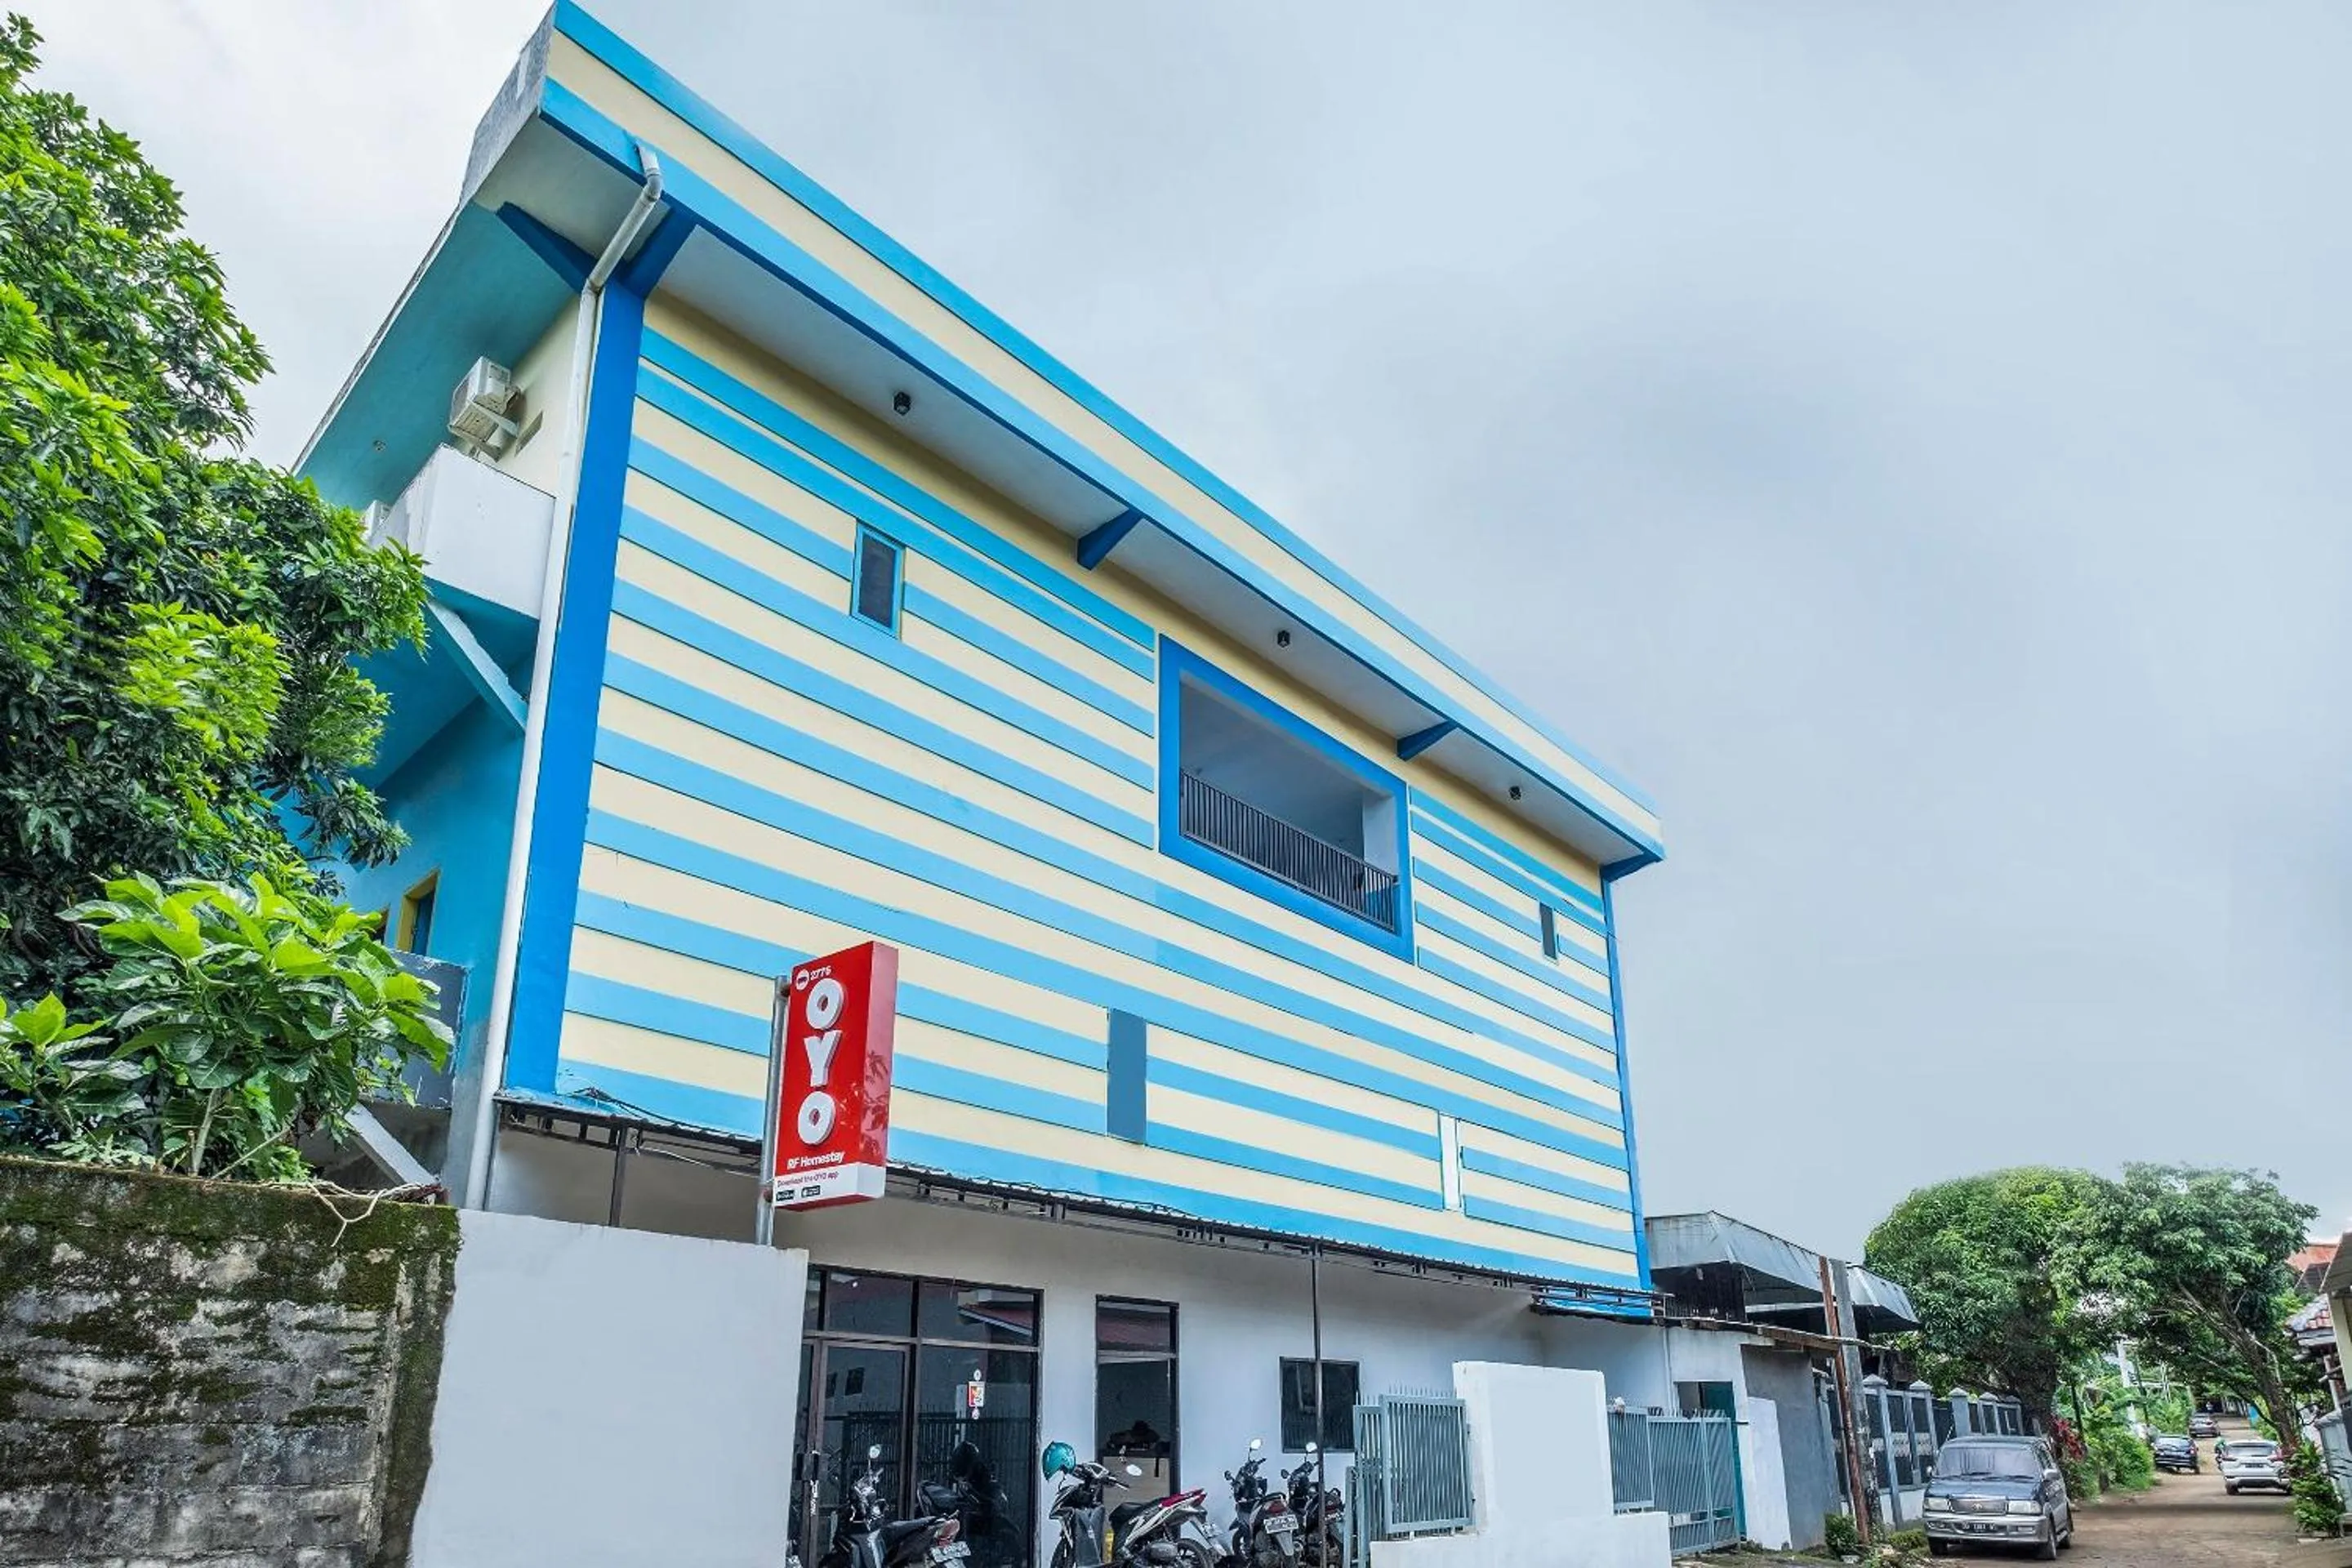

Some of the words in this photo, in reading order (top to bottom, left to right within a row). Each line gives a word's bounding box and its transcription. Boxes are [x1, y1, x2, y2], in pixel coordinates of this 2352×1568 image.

[798, 978, 844, 1145] OYO
[786, 1156, 800, 1170] RF
[800, 1152, 845, 1168] Homestay
